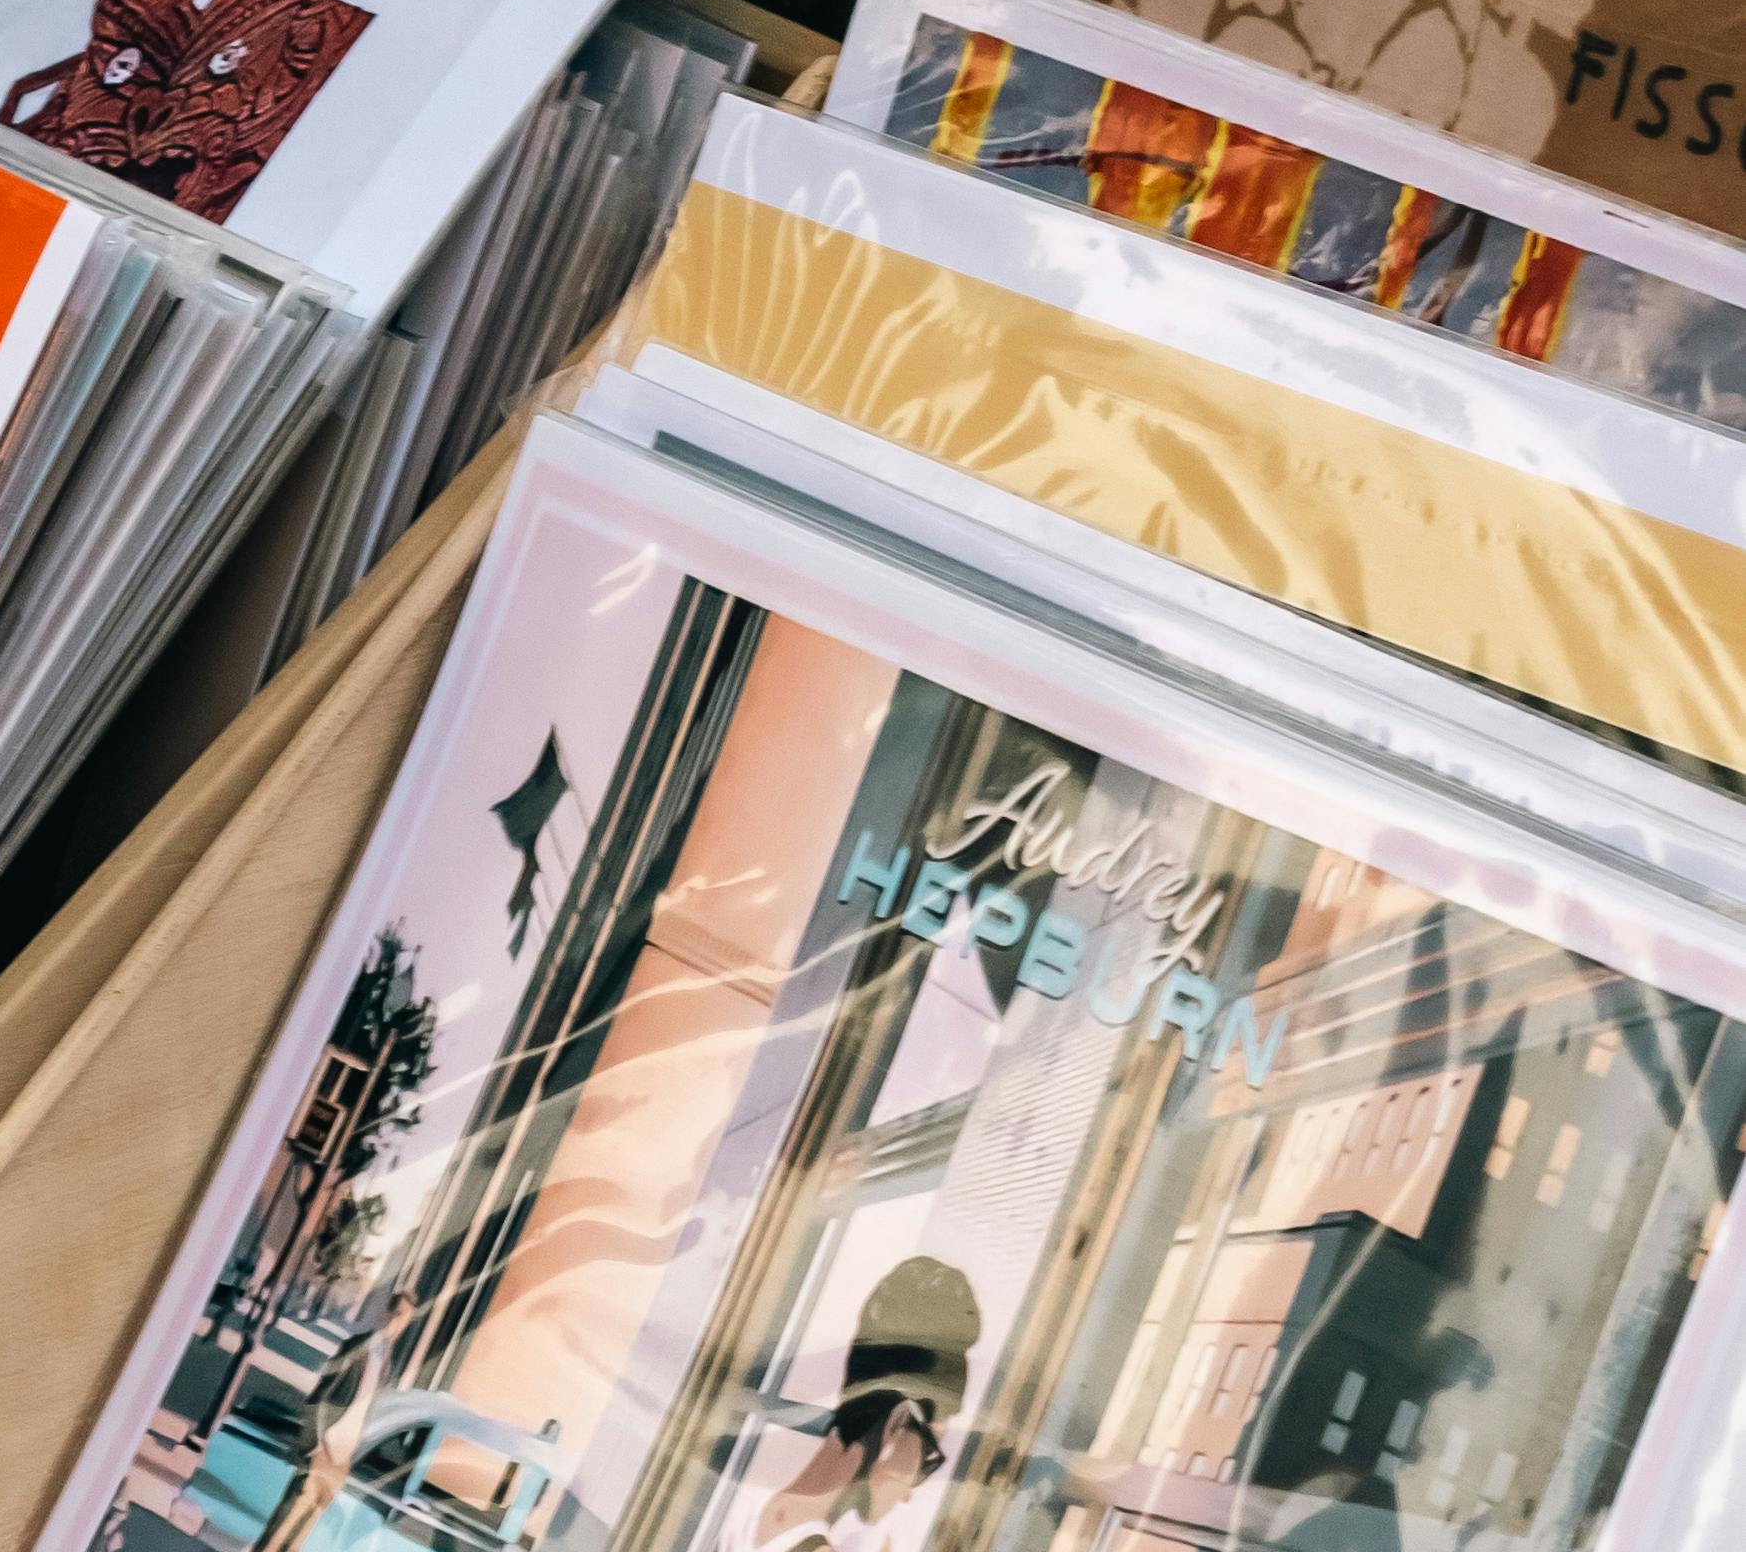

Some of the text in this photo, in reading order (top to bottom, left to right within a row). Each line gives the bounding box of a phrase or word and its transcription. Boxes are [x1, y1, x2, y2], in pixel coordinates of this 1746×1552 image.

[1565, 26, 1746, 175] FISS
[835, 828, 1290, 1090] HEPBURN
[924, 757, 1226, 982] Audrey
